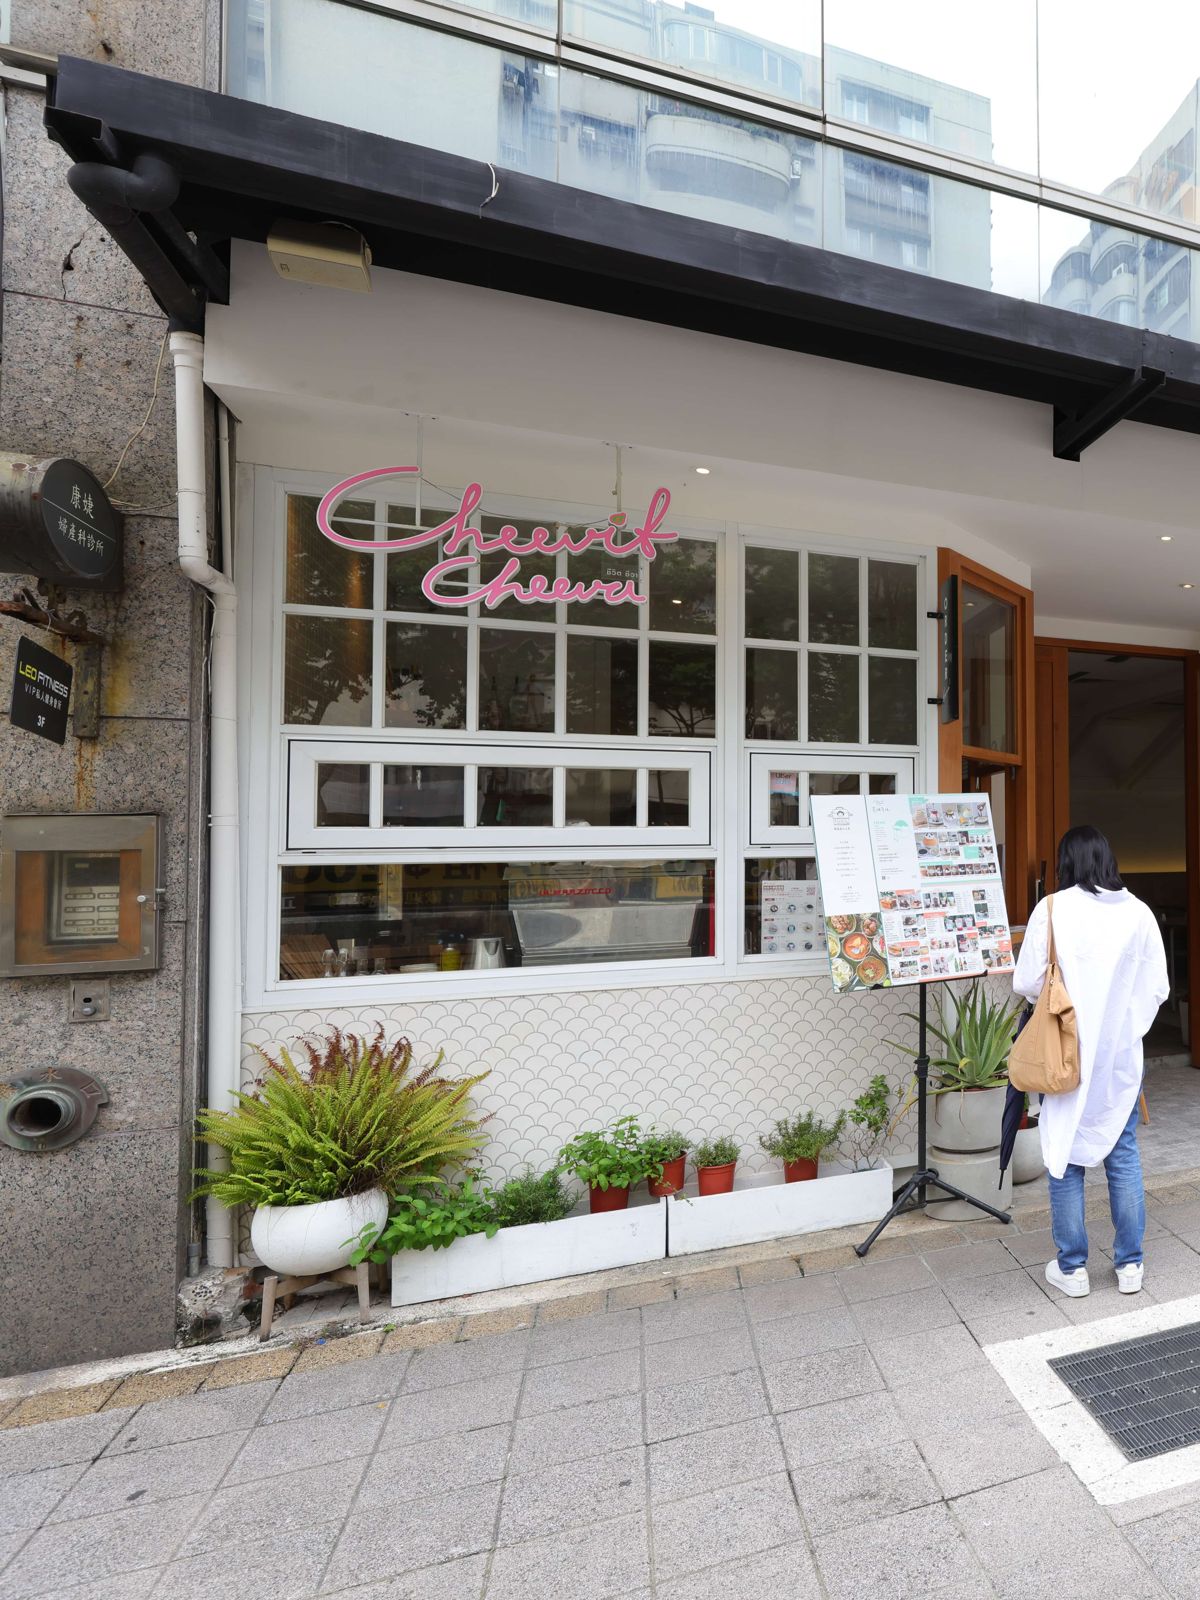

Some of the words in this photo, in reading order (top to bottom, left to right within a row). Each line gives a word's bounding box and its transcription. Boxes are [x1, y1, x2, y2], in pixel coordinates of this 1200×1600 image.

[316, 466, 679, 560] Cheevit
[58, 516, 104, 557] 婦產科診所
[421, 556, 648, 610] Cheeva
[19, 661, 37, 681] LEO
[37, 671, 69, 698] FITNESS
[37, 715, 46, 728] 3F
